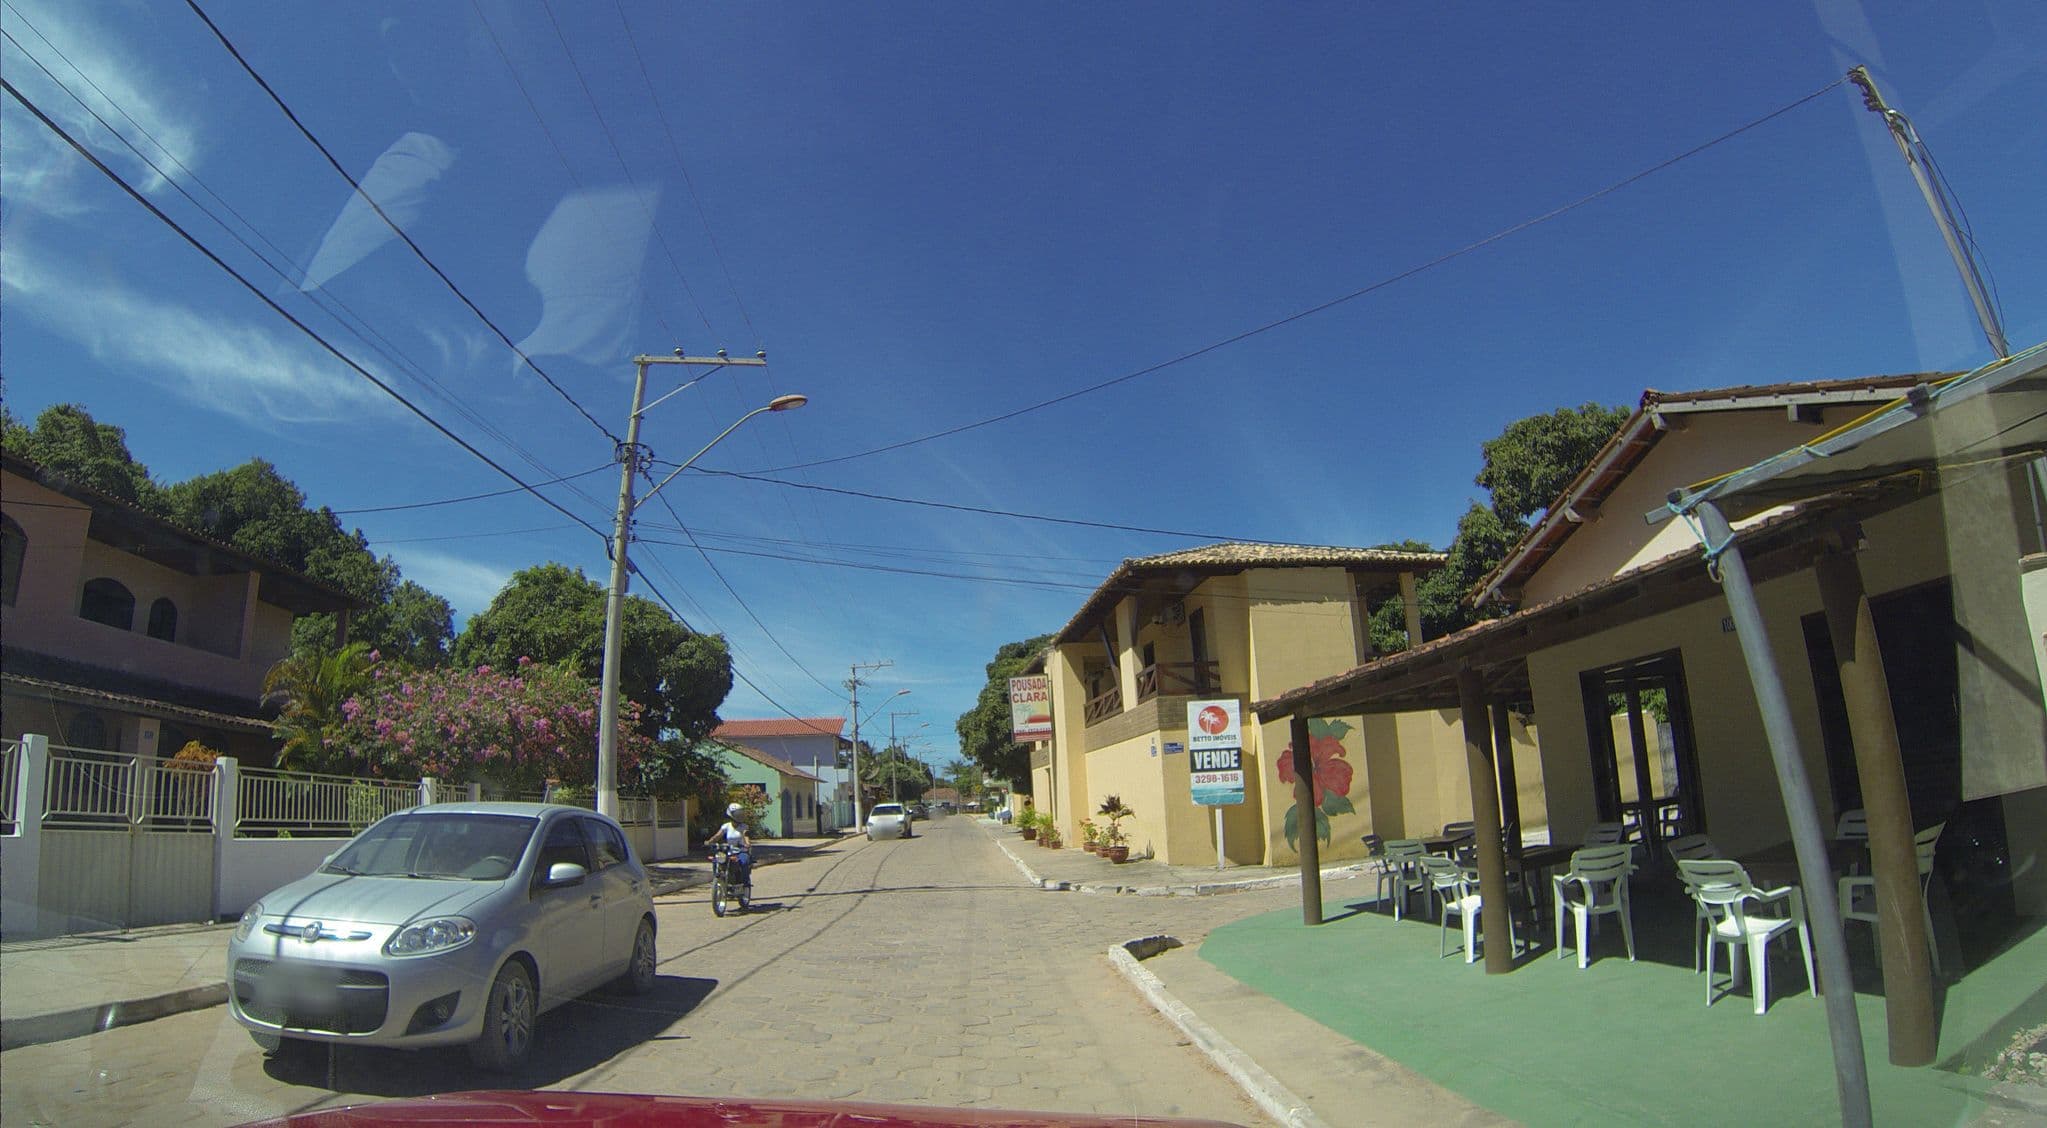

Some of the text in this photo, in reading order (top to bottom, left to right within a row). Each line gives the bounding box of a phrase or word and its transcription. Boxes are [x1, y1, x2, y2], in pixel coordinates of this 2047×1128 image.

[1011, 678, 1047, 692] POUSADA
[1012, 692, 1048, 703] CLARA
[1194, 750, 1239, 770] VENDE
